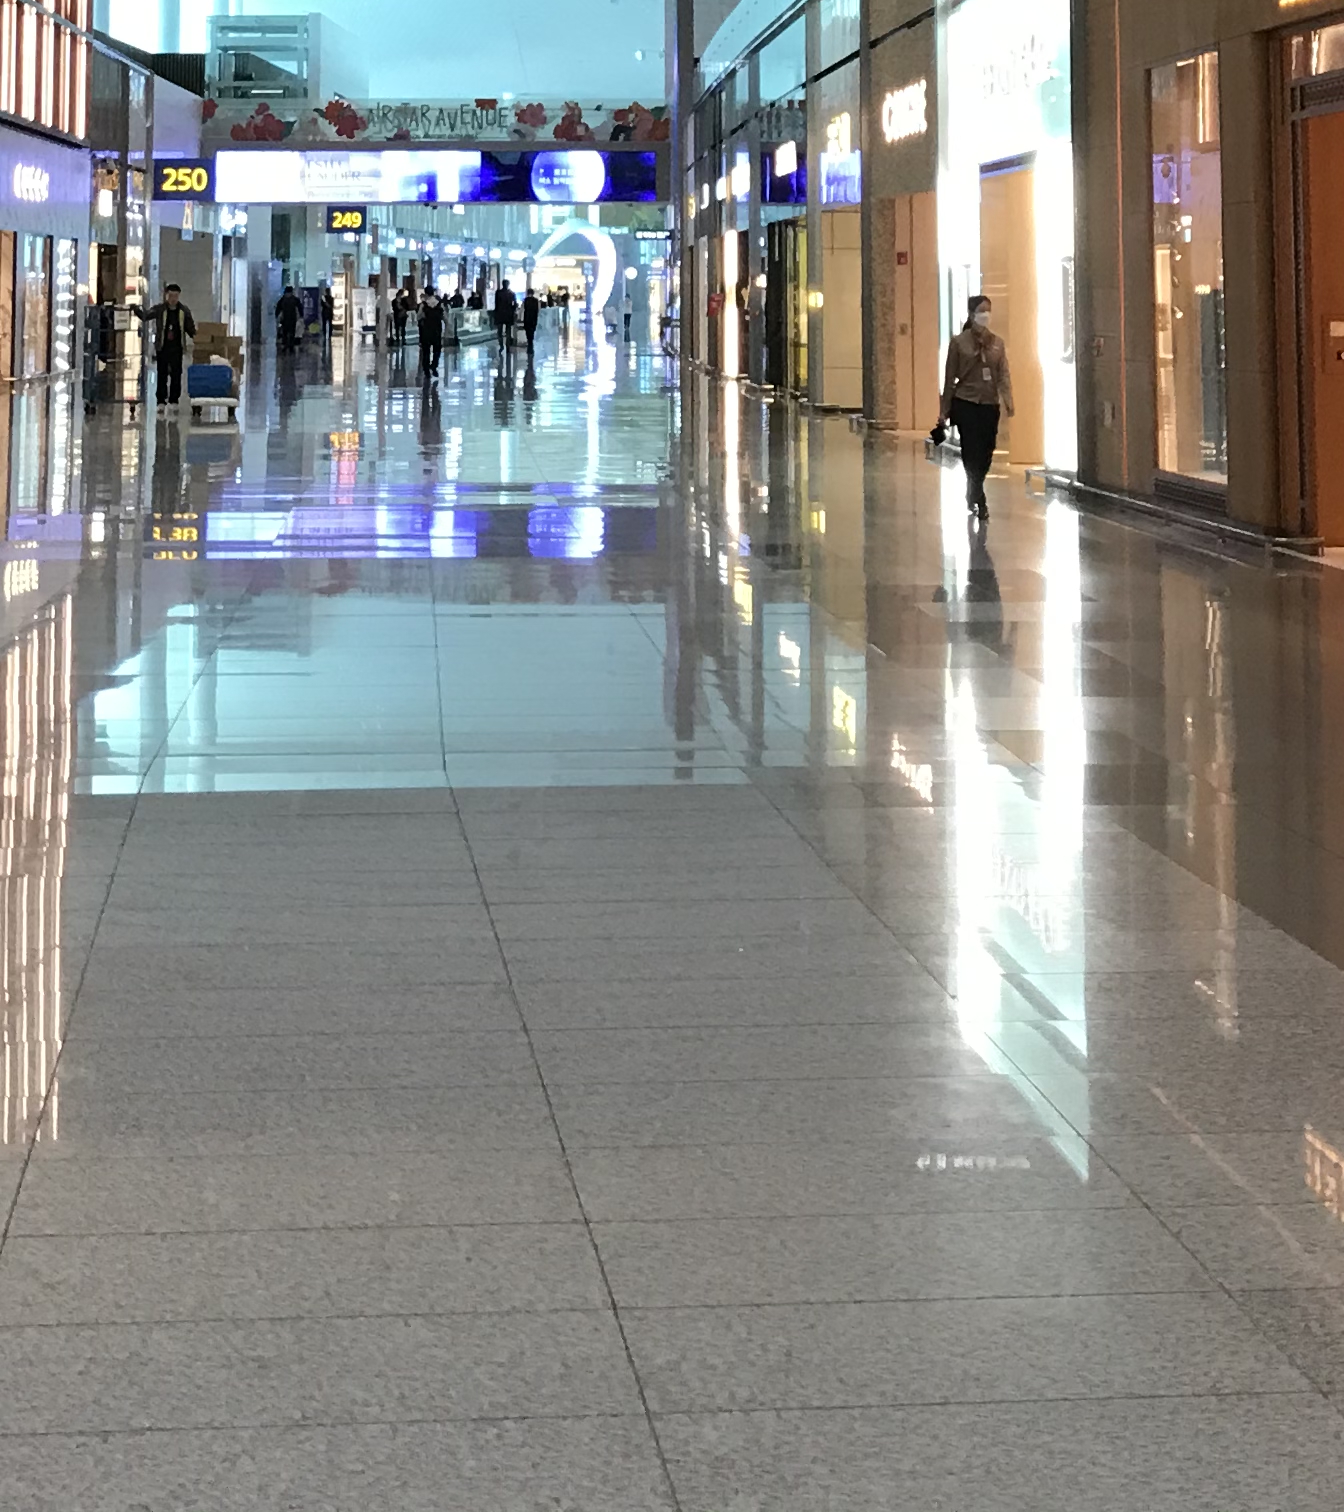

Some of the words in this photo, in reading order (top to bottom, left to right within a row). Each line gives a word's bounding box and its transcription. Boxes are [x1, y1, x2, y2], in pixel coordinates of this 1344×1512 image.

[435, 104, 509, 132] AVENUE
[161, 166, 209, 192] 250
[332, 211, 363, 229] 249
